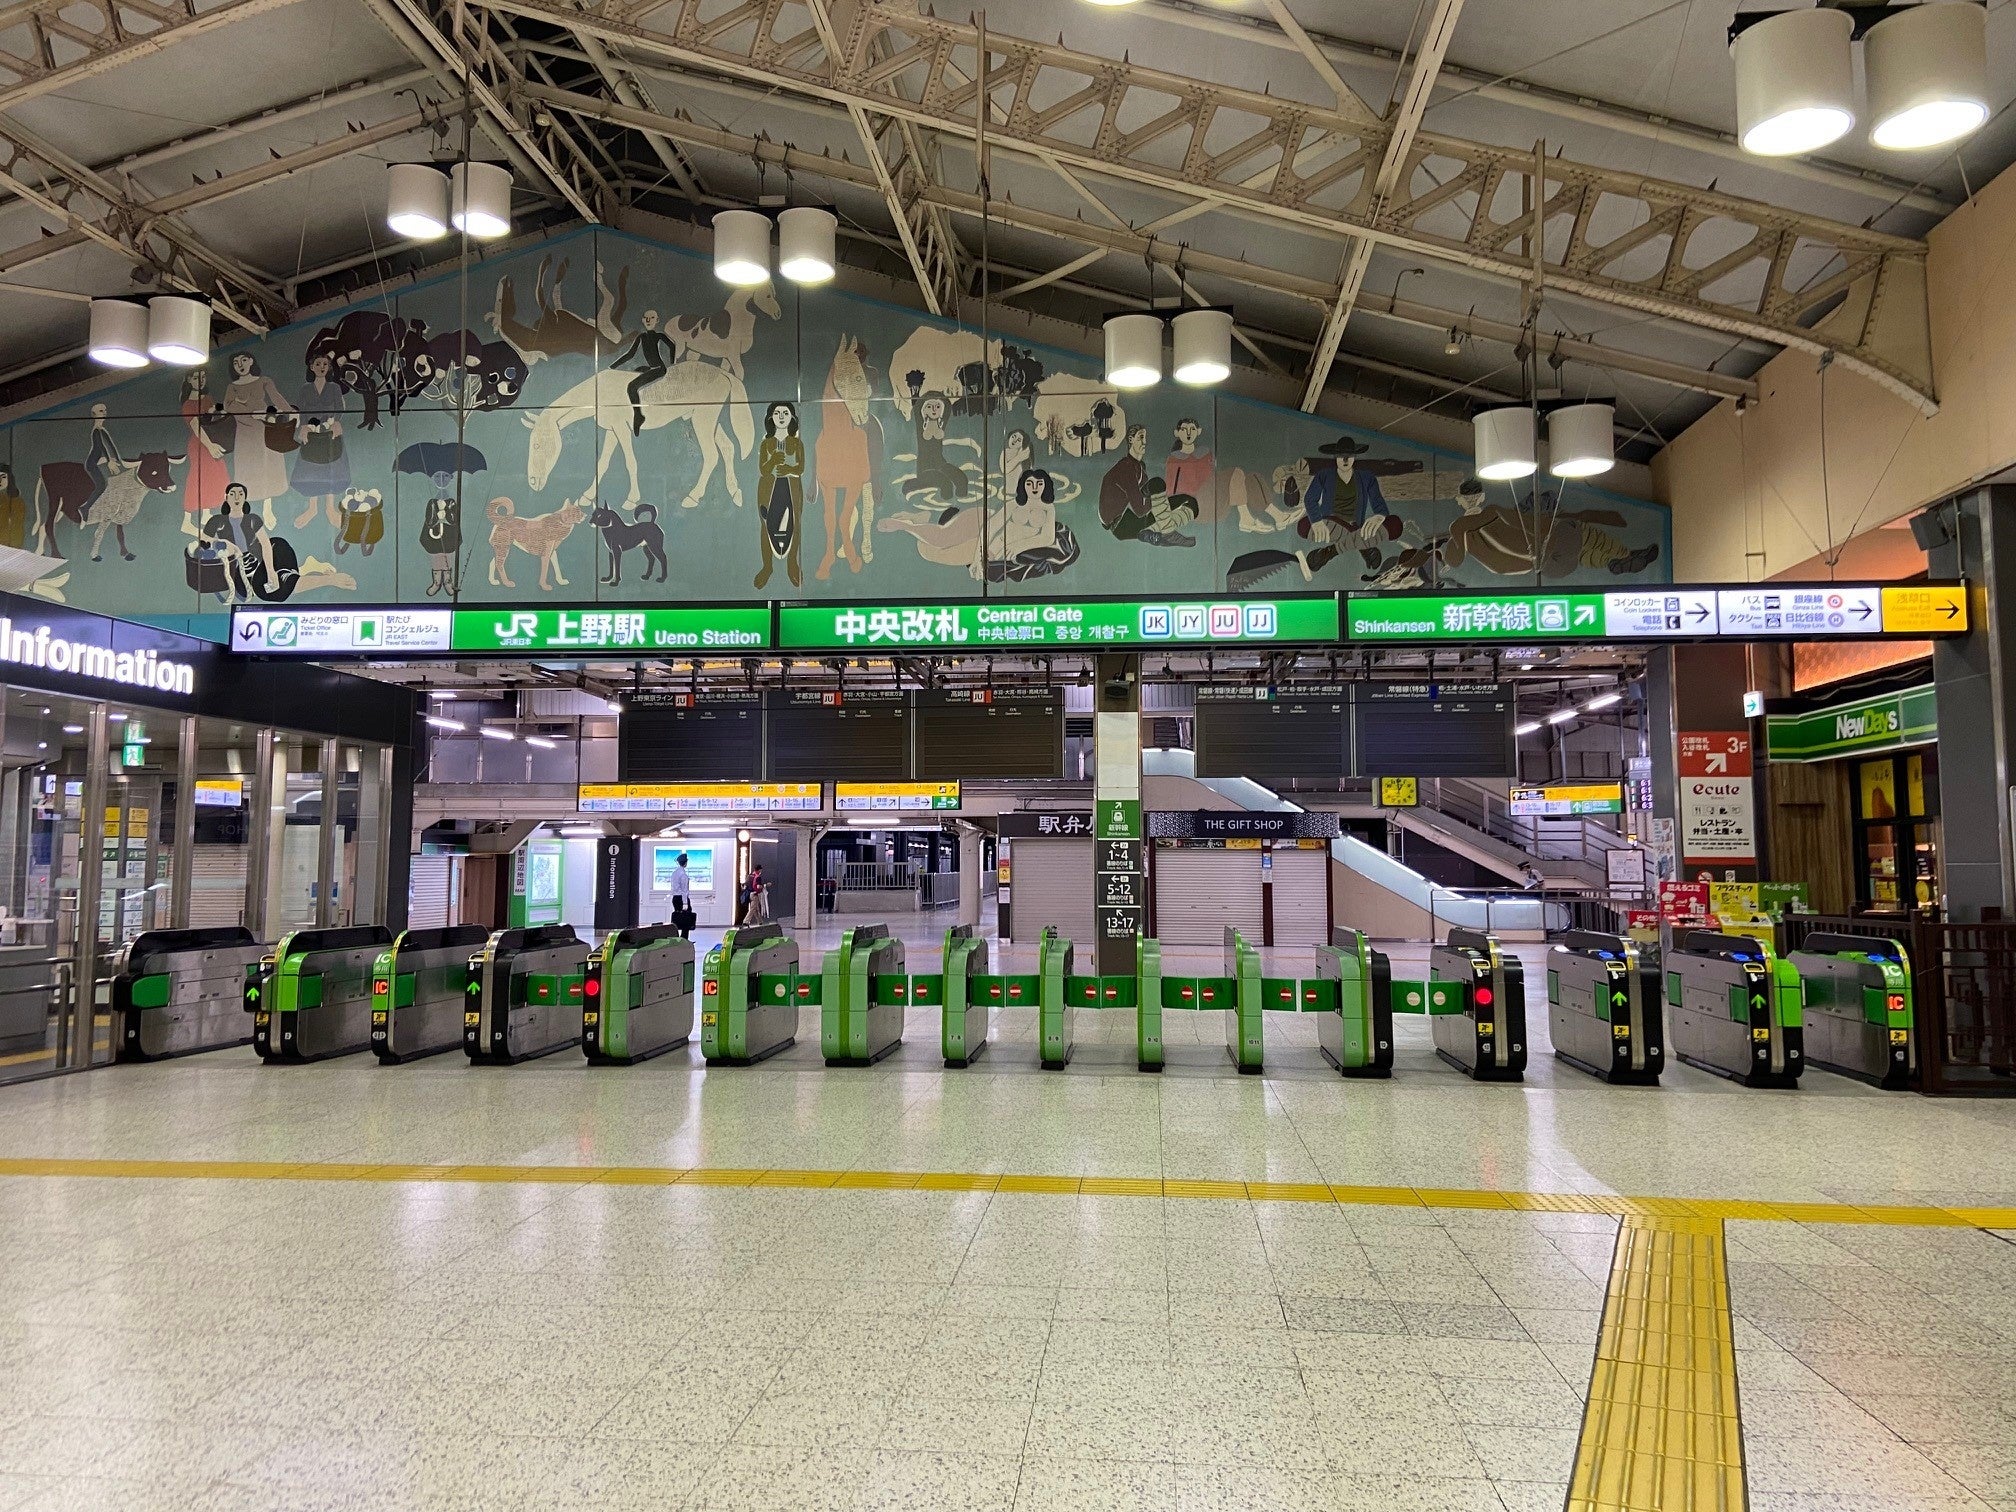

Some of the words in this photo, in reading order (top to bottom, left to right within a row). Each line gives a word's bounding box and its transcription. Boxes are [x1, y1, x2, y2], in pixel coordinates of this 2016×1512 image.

[1614, 598, 1661, 607] コインロッカー
[1742, 596, 1760, 604] バス
[1794, 594, 1823, 603] 銀座線
[300, 616, 349, 624] みどりの窓口
[386, 615, 412, 624] 駅たび
[977, 607, 1038, 623] Central
[1043, 606, 1083, 622] Gate
[1216, 614, 1234, 627] JU
[1252, 614, 1267, 627] JJ
[1442, 602, 1533, 632] 新幹線
[1642, 615, 1662, 624] 電話
[1729, 613, 1762, 623] タクシー
[1785, 613, 1824, 622] 日比谷線
[495, 613, 539, 638] JR
[834, 608, 969, 643] 中央改札
[1147, 615, 1164, 628] JK
[1181, 615, 1199, 628] JY
[1354, 620, 1436, 633] Shinkansen
[385, 625, 440, 634] コンシェルジュ
[546, 612, 646, 645] 上野駅
[1055, 625, 1083, 640] 중앙
[1088, 624, 1130, 640] 개찰구
[654, 630, 698, 645] Ueno
[702, 629, 761, 645] Station
[0, 617, 194, 695] Information
[630, 694, 674, 702] 上野東京ライン
[676, 696, 686, 704] JU
[974, 692, 983, 700] JU
[1836, 709, 1898, 740] NewDays
[1726, 737, 1747, 754] 3F
[1692, 783, 1740, 795] ecute
[1204, 819, 1225, 829] THE
[1228, 819, 1252, 829] GIFT
[1254, 819, 1284, 830] SHOP
[1700, 819, 1736, 827] レストラン
[609, 857, 617, 899] Information
[1666, 884, 1701, 892] 燃えるゴミ
[1715, 884, 1753, 892] プラスチック
[375, 953, 392, 964] IC
[705, 953, 721, 964] IC
[1882, 965, 1903, 977] IC
[375, 980, 388, 994] IC
[703, 980, 717, 995] IC
[1888, 996, 1904, 1010] IC
